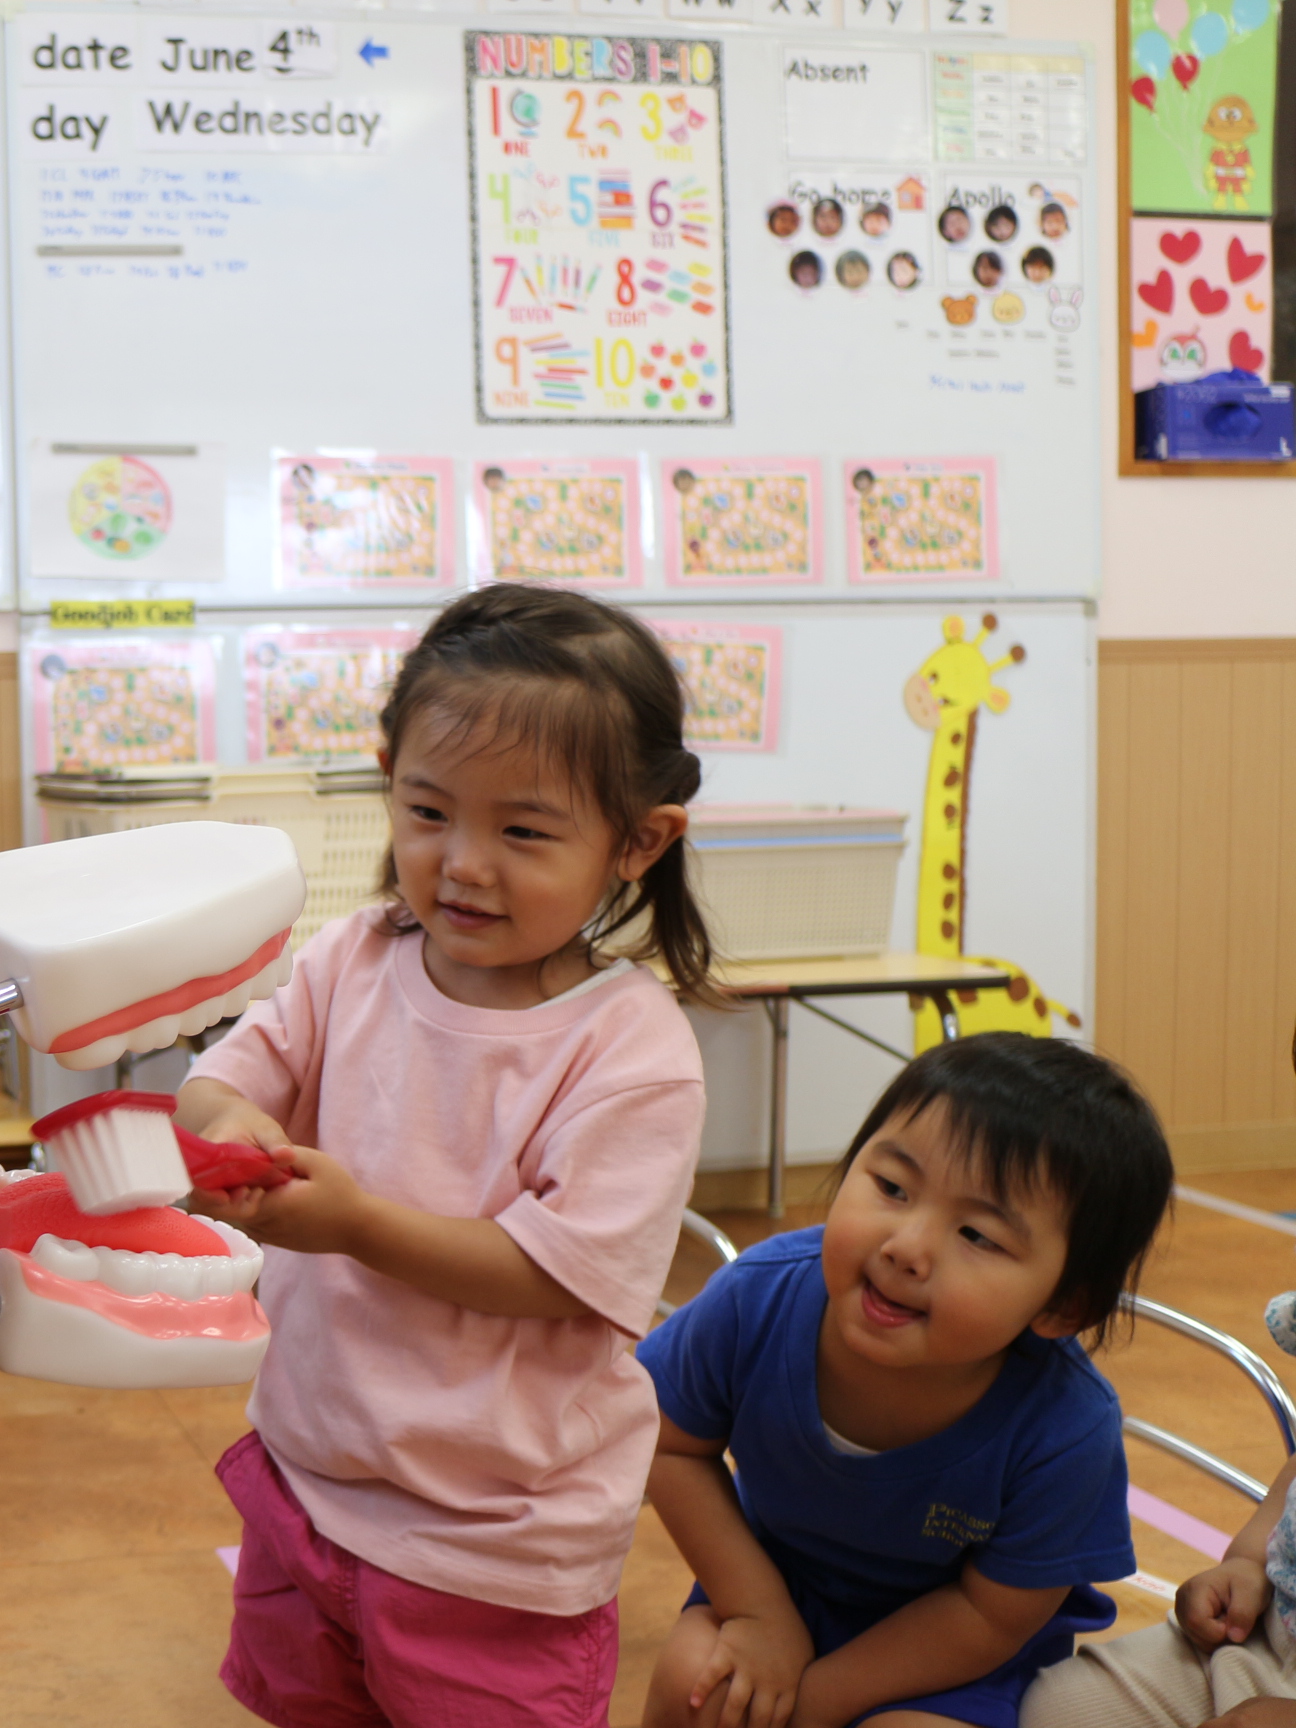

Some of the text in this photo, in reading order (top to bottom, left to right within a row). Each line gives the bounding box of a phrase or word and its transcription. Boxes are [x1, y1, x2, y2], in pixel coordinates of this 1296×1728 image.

[33, 27, 321, 73] date June 4th
[477, 35, 714, 83] NUMBERS 1-10
[786, 61, 870, 84] Absent
[32, 101, 382, 150] day Wednesday
[490, 86, 501, 137] 1
[565, 89, 586, 138] 2
[639, 91, 663, 141] 3
[488, 173, 511, 224] 4
[568, 175, 593, 226] 5
[648, 179, 673, 228] 6
[832, 181, 893, 203] home
[947, 185, 1017, 209] Apollo
[492, 256, 517, 308] 7
[616, 257, 637, 307] 8
[495, 336, 519, 387] 9
[594, 337, 636, 389] 10
